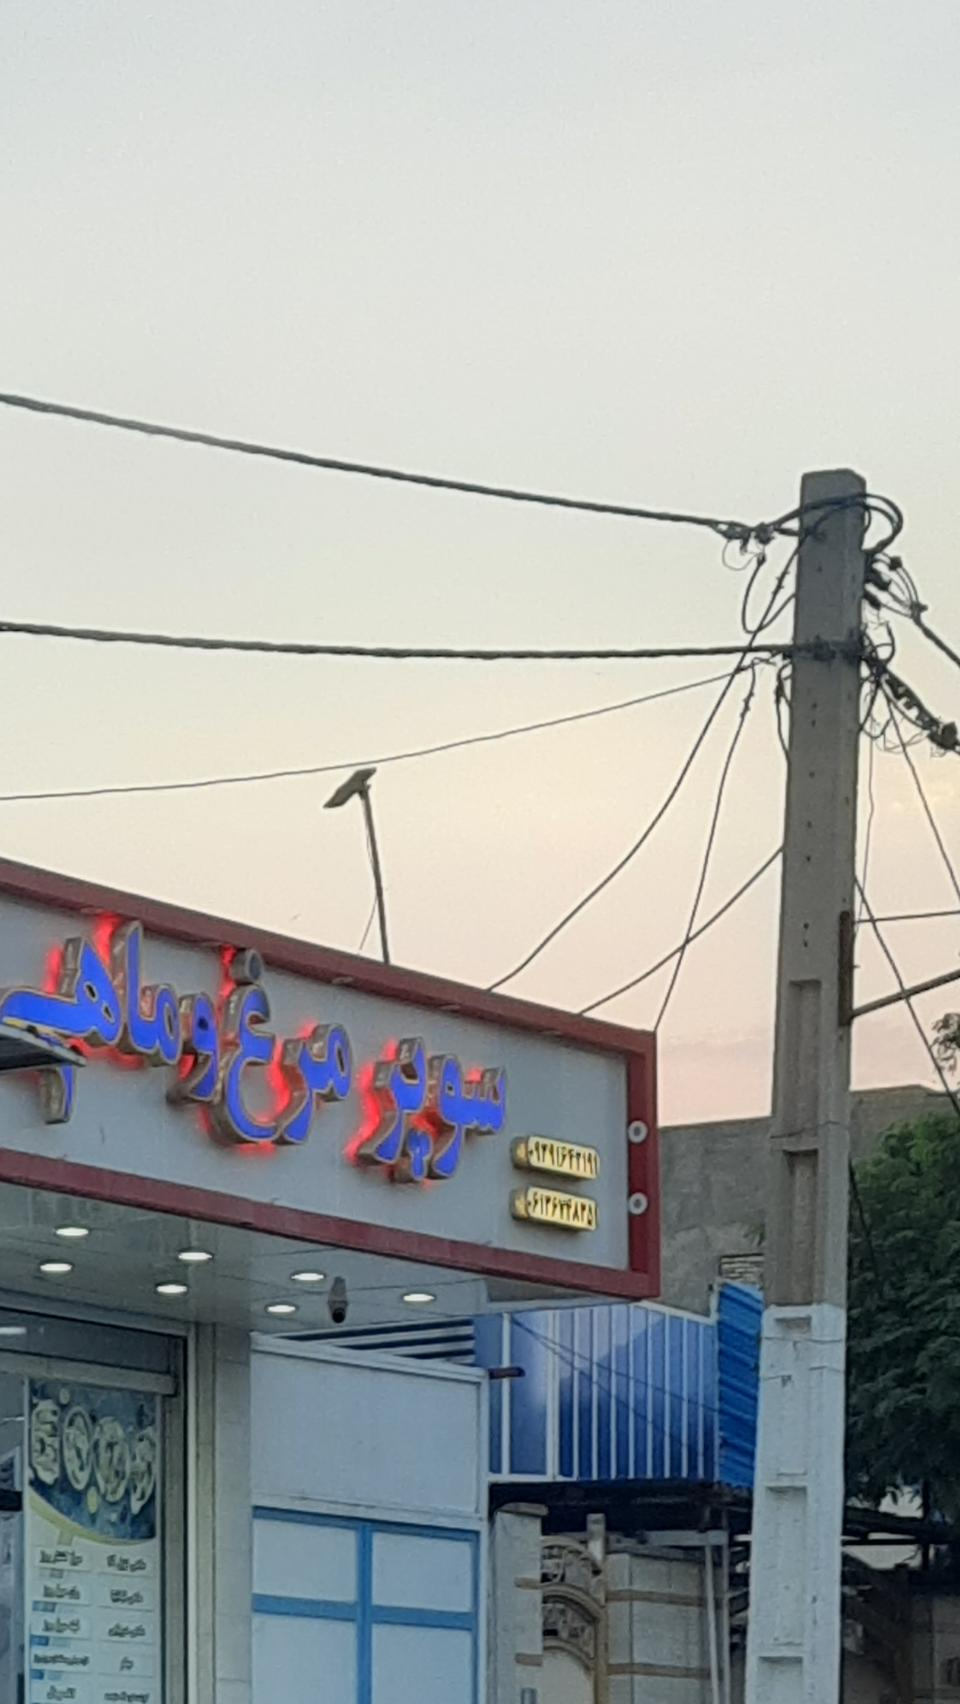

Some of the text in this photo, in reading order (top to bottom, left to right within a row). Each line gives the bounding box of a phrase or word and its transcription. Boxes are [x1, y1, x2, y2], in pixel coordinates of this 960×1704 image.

[174, 990, 221, 1103] و
[214, 948, 353, 1145] مرغ
[360, 1036, 507, 1183] سوپر
